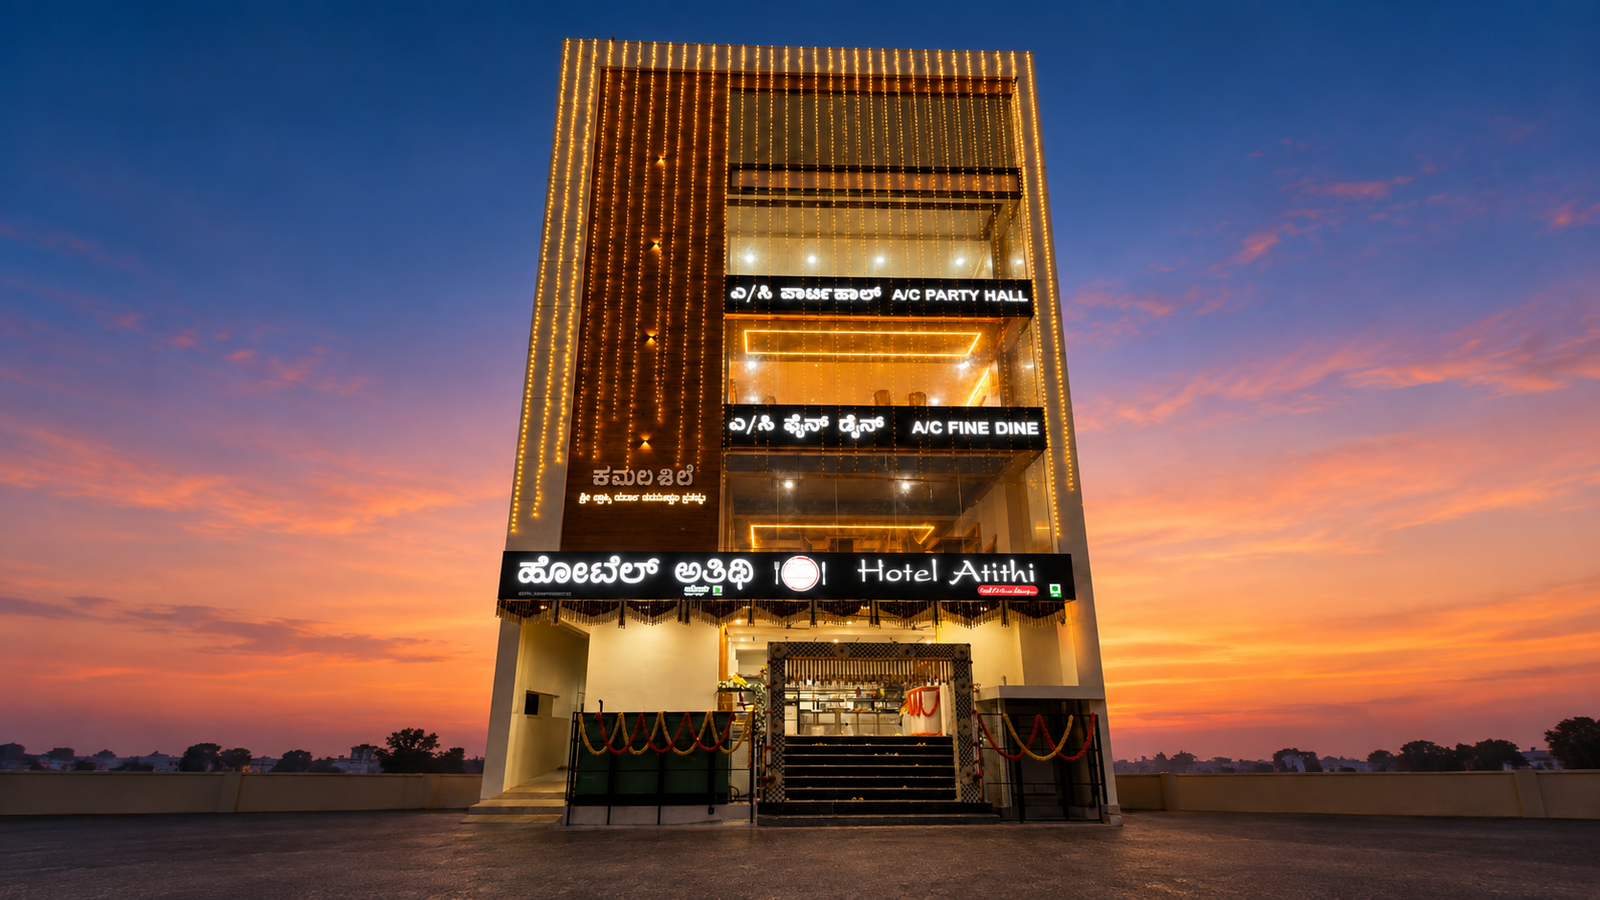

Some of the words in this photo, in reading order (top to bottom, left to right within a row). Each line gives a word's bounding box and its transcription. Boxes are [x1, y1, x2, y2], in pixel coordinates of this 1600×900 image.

[892, 288, 921, 301] A/C
[925, 288, 980, 302] PARTY
[985, 290, 1029, 303] HALL
[911, 421, 943, 435] A/C
[948, 421, 990, 435] FINE
[995, 421, 1040, 436] DINE
[517, 555, 661, 584] ಹೋಟೆಲ್
[857, 558, 938, 583] Hotel
[948, 558, 1036, 586] Atithi
